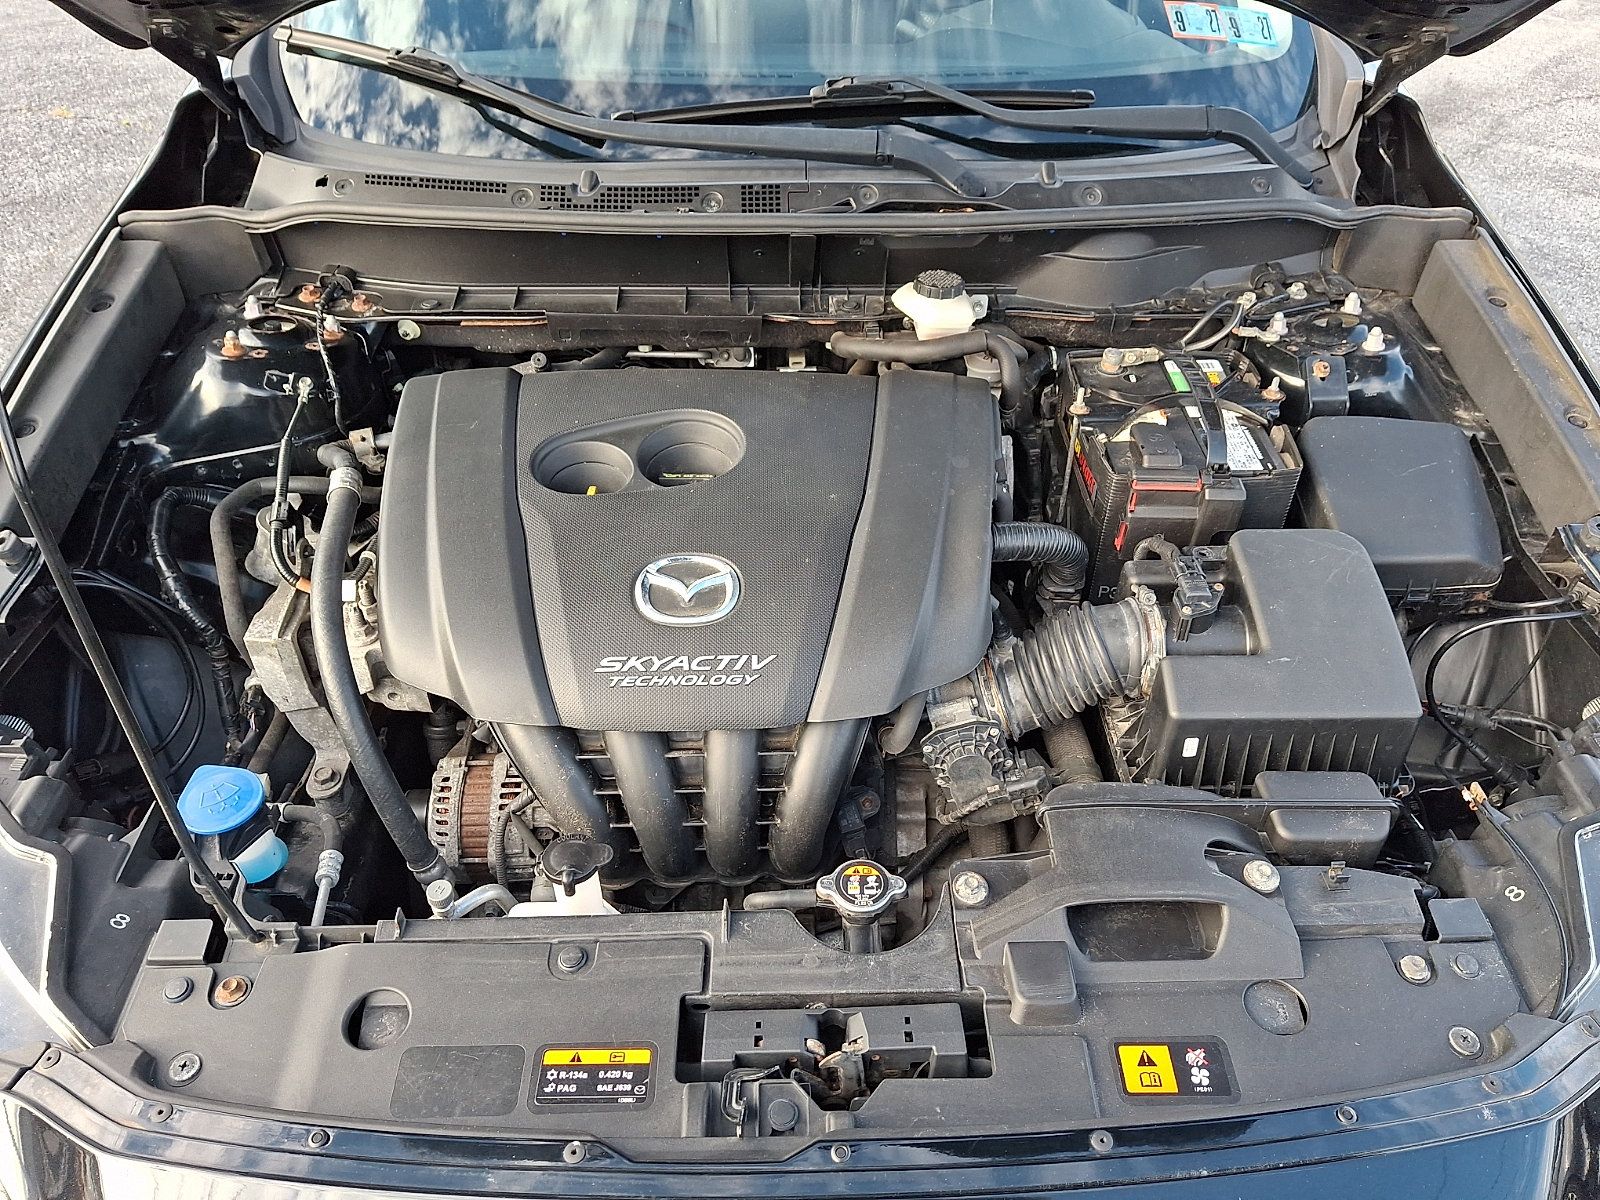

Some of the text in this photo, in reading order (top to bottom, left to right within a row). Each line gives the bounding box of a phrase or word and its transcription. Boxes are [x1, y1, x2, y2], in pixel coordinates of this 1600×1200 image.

[1174, 9, 1221, 34] 9 27
[1228, 15, 1272, 41] 9 27
[594, 654, 778, 673] SKYACTIV
[609, 674, 762, 688] TECHNOLOGY
[1504, 885, 1525, 902] 8
[109, 913, 131, 929] 8
[558, 1070, 589, 1080] R-134a
[622, 1070, 634, 1080] kg
[556, 1084, 577, 1093] PAG
